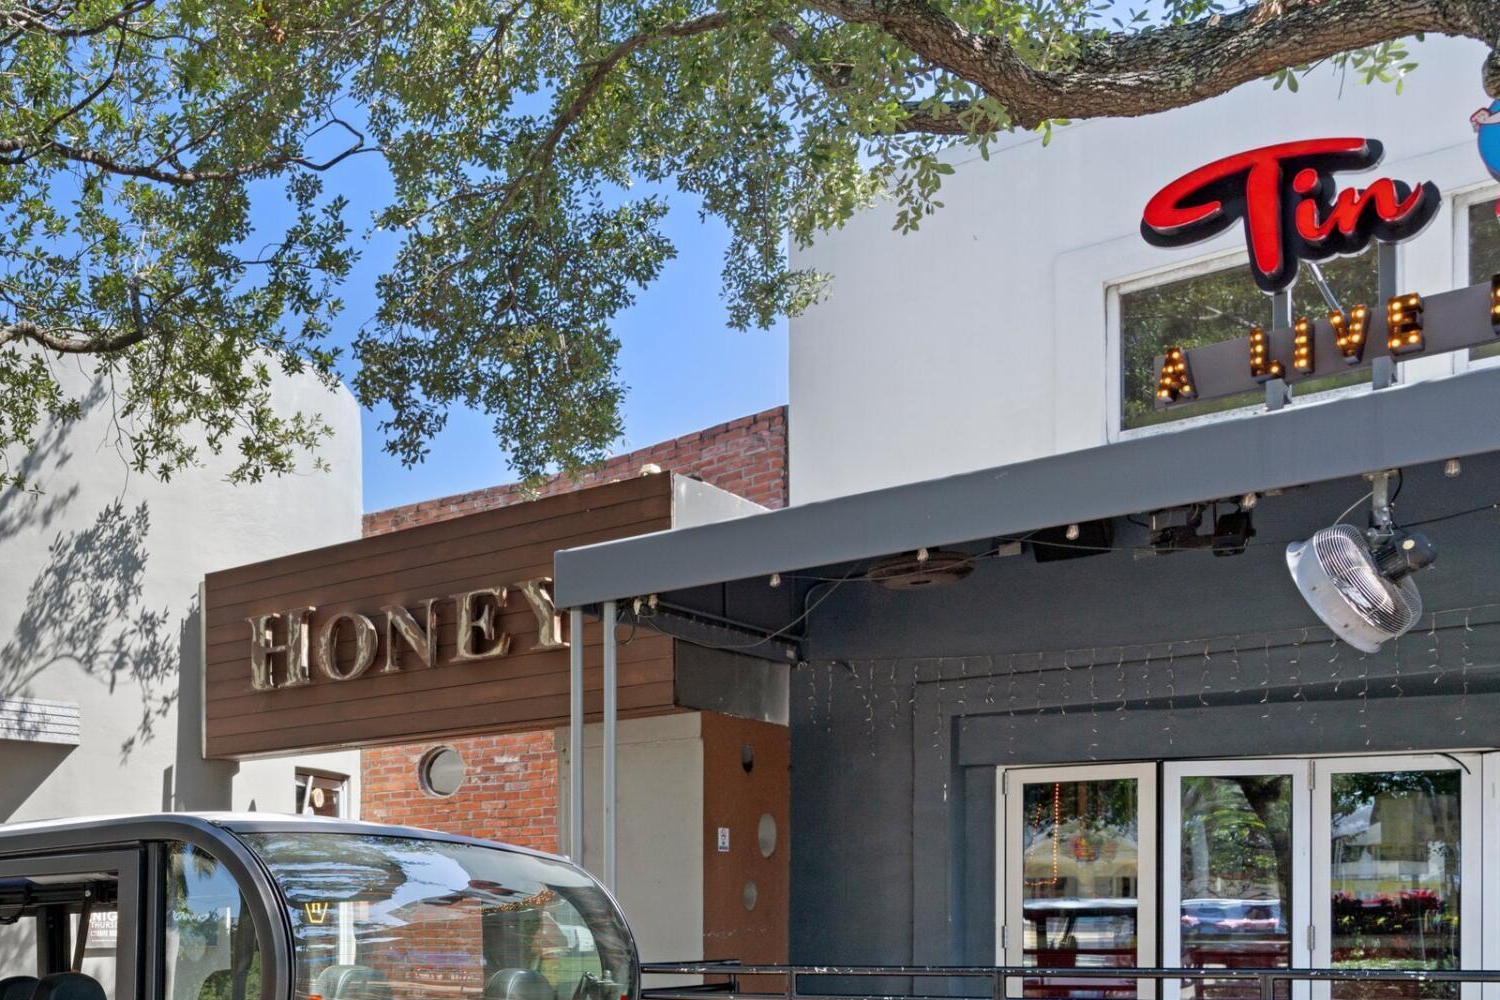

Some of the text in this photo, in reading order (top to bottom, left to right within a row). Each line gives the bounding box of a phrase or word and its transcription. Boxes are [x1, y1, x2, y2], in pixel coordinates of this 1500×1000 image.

[1141, 137, 1441, 292] Tin
[1156, 347, 1197, 402] A
[1250, 292, 1425, 383] LIVE
[244, 577, 571, 691] HONEY
[91, 911, 117, 921] NIG
